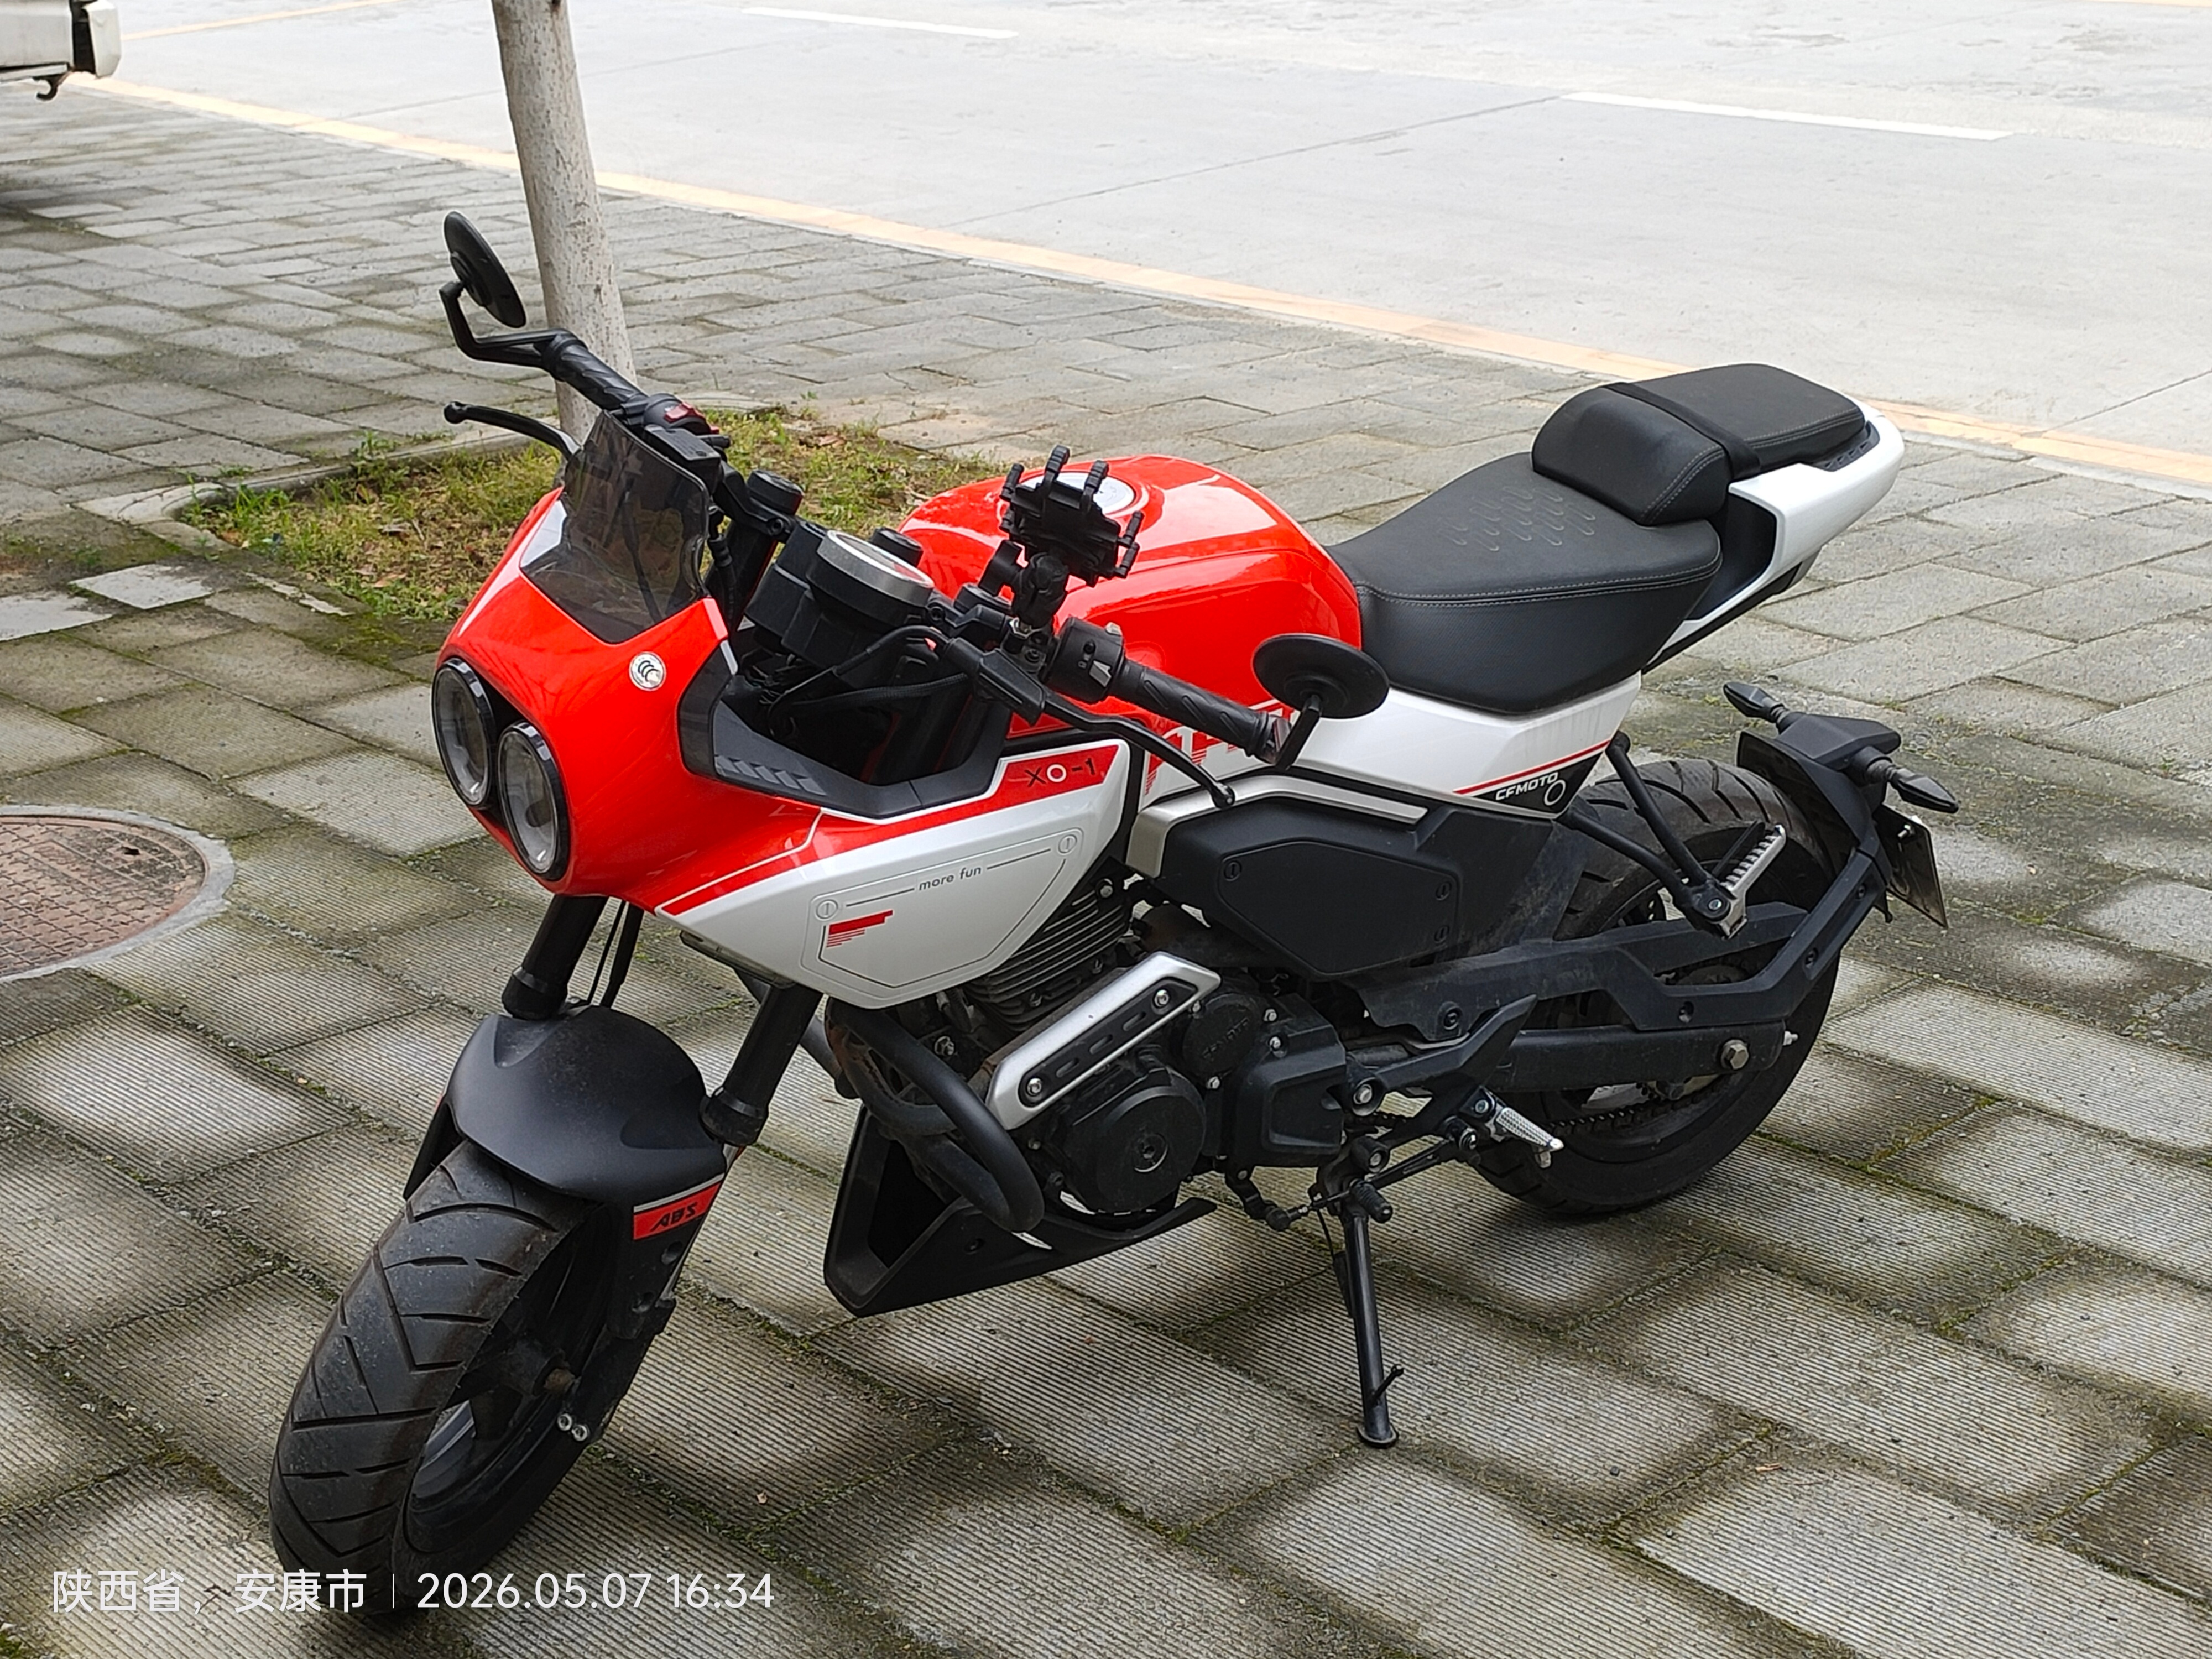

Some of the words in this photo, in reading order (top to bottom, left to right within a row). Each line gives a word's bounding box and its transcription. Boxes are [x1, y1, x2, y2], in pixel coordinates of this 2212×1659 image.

[1024, 758, 1095, 787] XO-1
[1495, 771, 1558, 800] CFMOTO
[919, 874, 954, 891] more
[959, 867, 982, 880] fun
[650, 1202, 698, 1232] ABS
